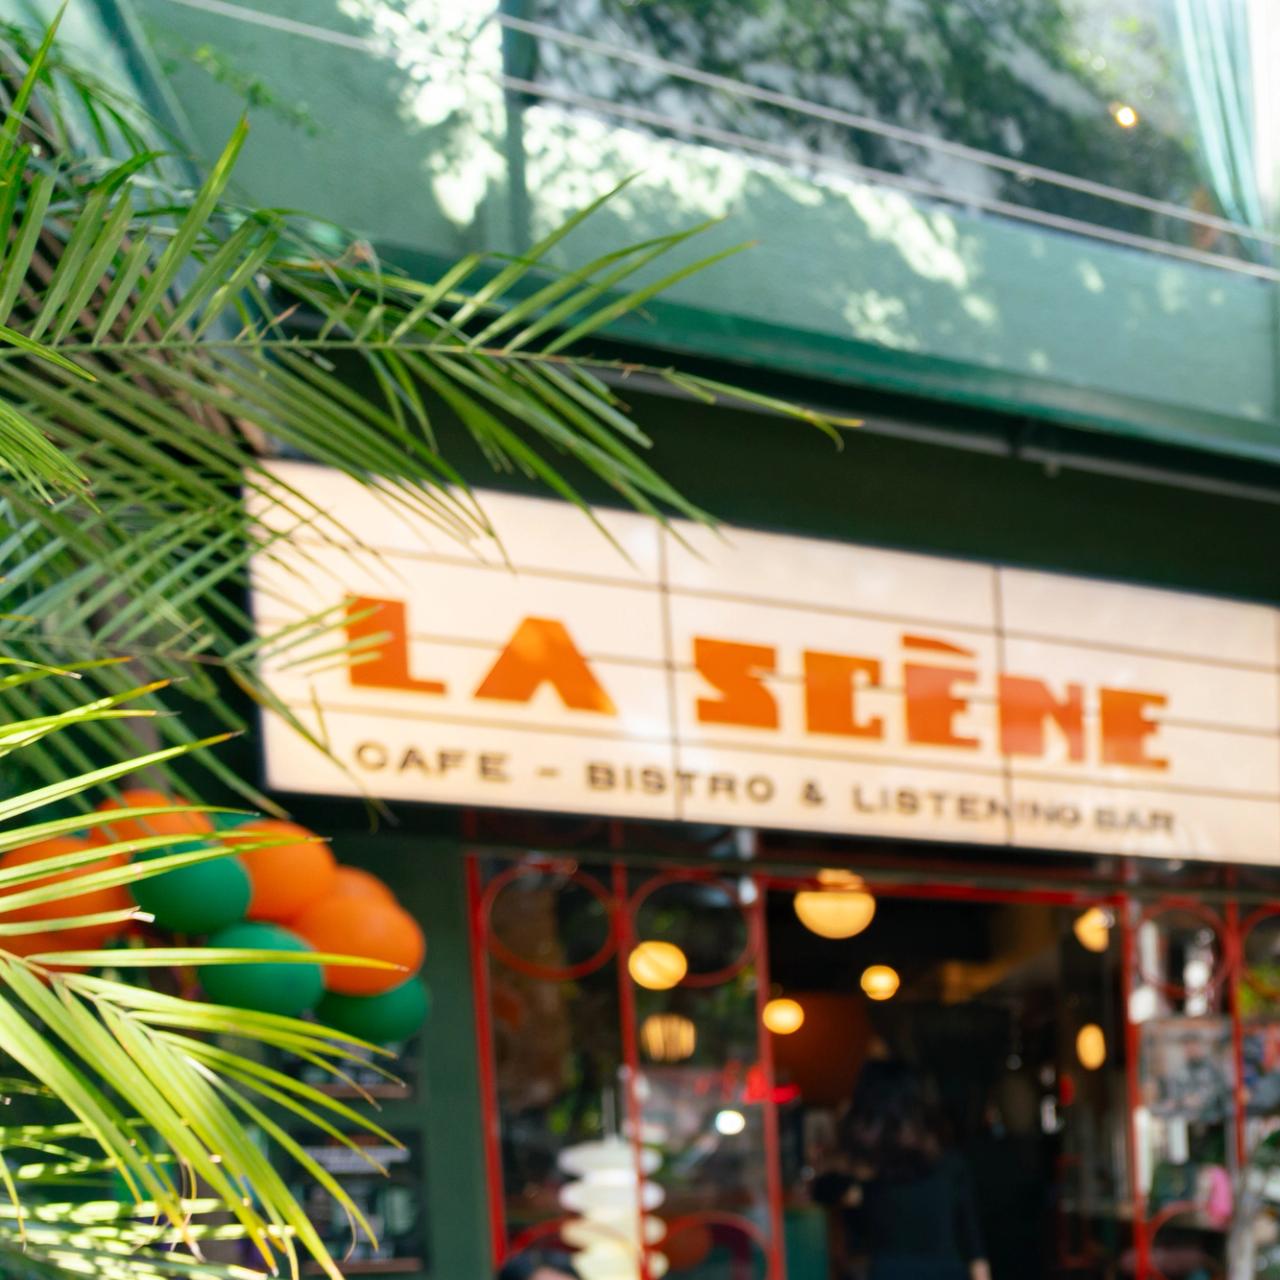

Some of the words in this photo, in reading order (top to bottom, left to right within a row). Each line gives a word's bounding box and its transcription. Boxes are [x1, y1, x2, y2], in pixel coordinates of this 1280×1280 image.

[346, 594, 618, 716] LA
[694, 634, 1168, 769] SCÈNE
[356, 741, 511, 782] CAFE
[586, 762, 776, 803] BISTRO
[803, 781, 825, 806] &
[853, 785, 1080, 827] LISTENING
[1094, 804, 1175, 832] BAR
